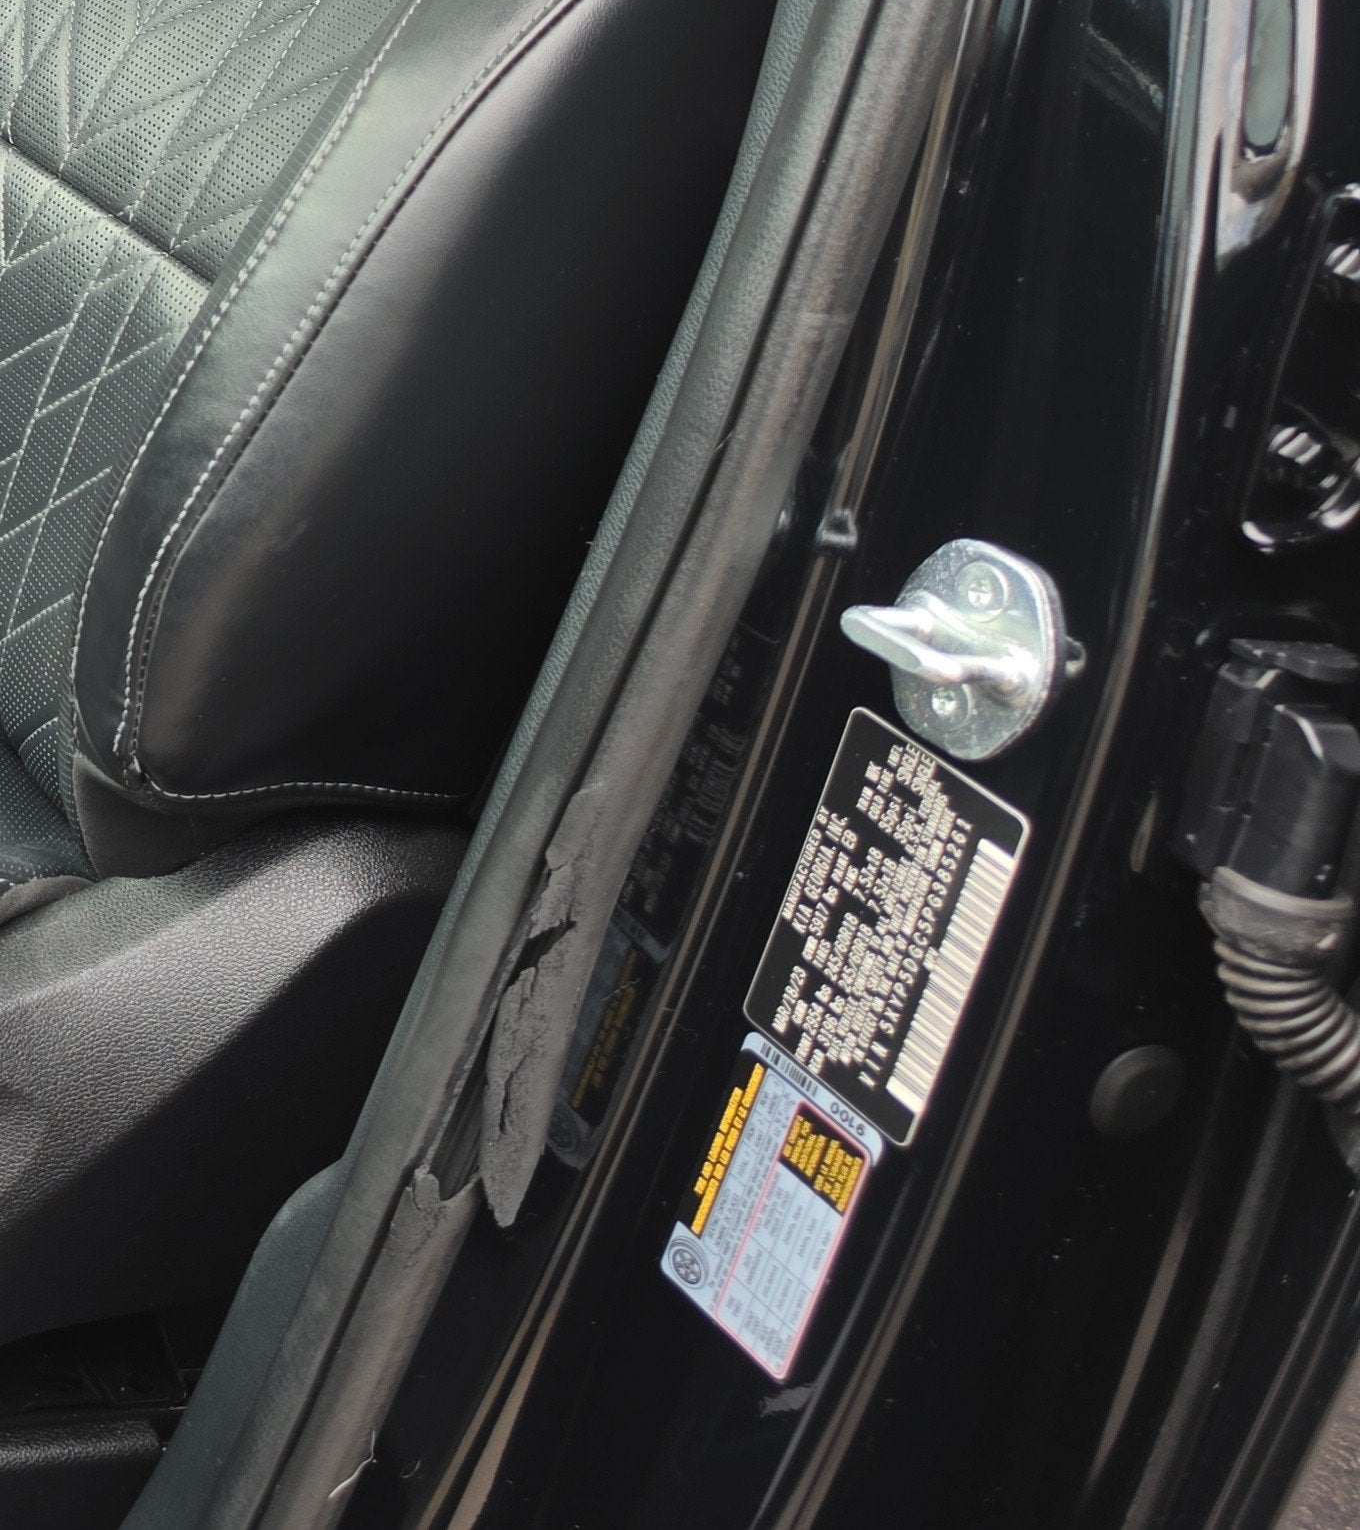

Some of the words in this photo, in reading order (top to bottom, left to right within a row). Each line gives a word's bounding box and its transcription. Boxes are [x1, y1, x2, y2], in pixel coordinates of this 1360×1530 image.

[771, 962, 807, 1036] MAR/18/23
[808, 901, 830, 938] 5917
[830, 850, 850, 885] PAINT
[841, 827, 858, 851] EB
[855, 784, 874, 813] TRIM
[781, 826, 822, 921] MANUFACTURED
[815, 804, 830, 826] BY
[791, 900, 813, 935] KIA
[824, 809, 848, 843] INC.
[803, 1000, 824, 1037] 2954
[822, 909, 859, 983] 245/60R18
[852, 843, 884, 905] 7.5Jx18
[877, 792, 905, 836] 35psi
[894, 743, 921, 787] SINGLE
[812, 937, 832, 971] TIRES
[841, 863, 859, 893] RIMS
[867, 793, 885, 822] COLD
[877, 767, 894, 795] TIRE
[815, 1010, 838, 1049] 3196
[836, 920, 873, 995] 245/60R18
[866, 854, 899, 916] 7.5Jx18
[891, 802, 919, 847] 35psi
[909, 753, 936, 798] SINGLE
[826, 1035, 844, 1065] THIS
[836, 995, 859, 1040] VEHICLE
[881, 855, 911, 916] APPLICABLE
[838, 1031, 859, 1067] MOTOR
[850, 990, 874, 1035] VEHICLE
[920, 790, 948, 846] STANDARDS
[899, 869, 932, 937] MANUFACTURE
